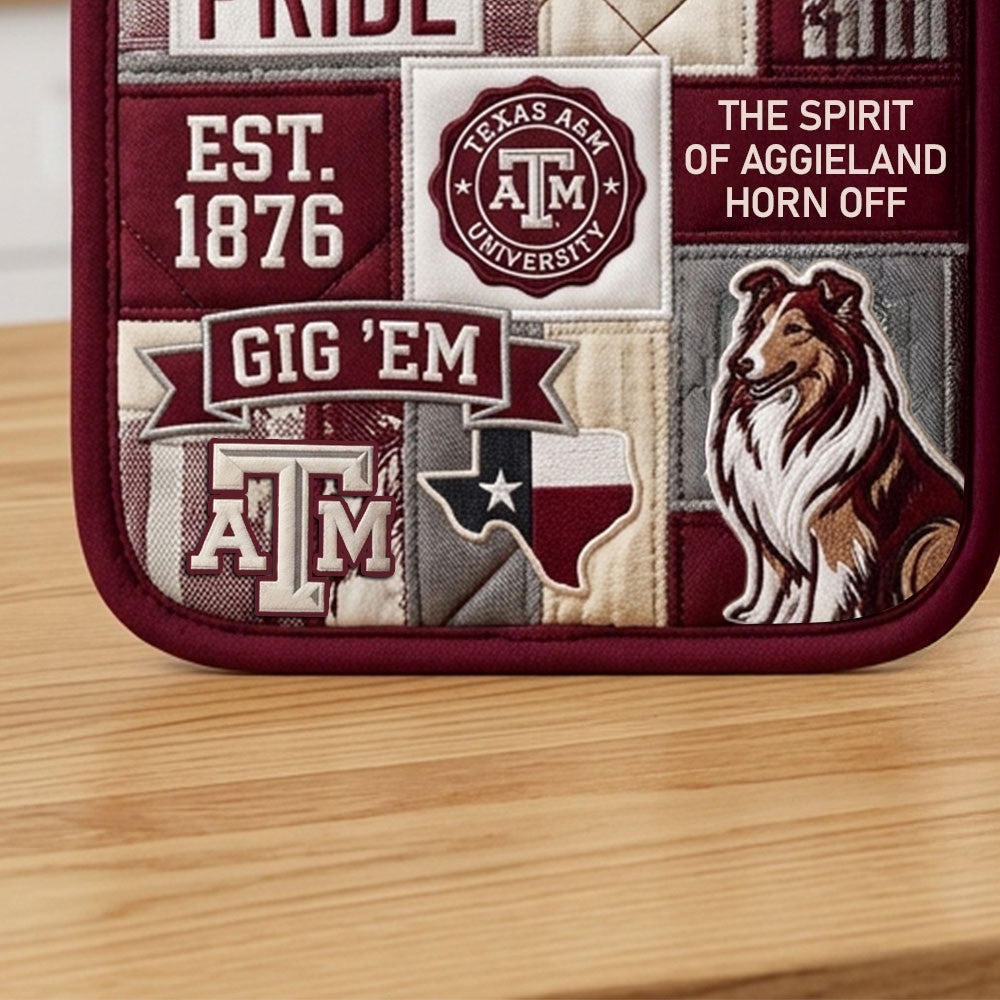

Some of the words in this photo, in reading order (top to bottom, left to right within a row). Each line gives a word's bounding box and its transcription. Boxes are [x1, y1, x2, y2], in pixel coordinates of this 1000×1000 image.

[463, 102, 546, 154] TEXAS
[718, 100, 788, 131] THE
[800, 100, 914, 131] SPIRIT
[187, 114, 334, 182] EST.
[685, 144, 731, 175] OF
[740, 144, 947, 175] AGGIELAND
[726, 187, 826, 218] HORN
[840, 187, 907, 218] OFF
[175, 194, 343, 269] 1876
[467, 220, 604, 271] UNIVERSITY
[231, 321, 340, 388] GIG
